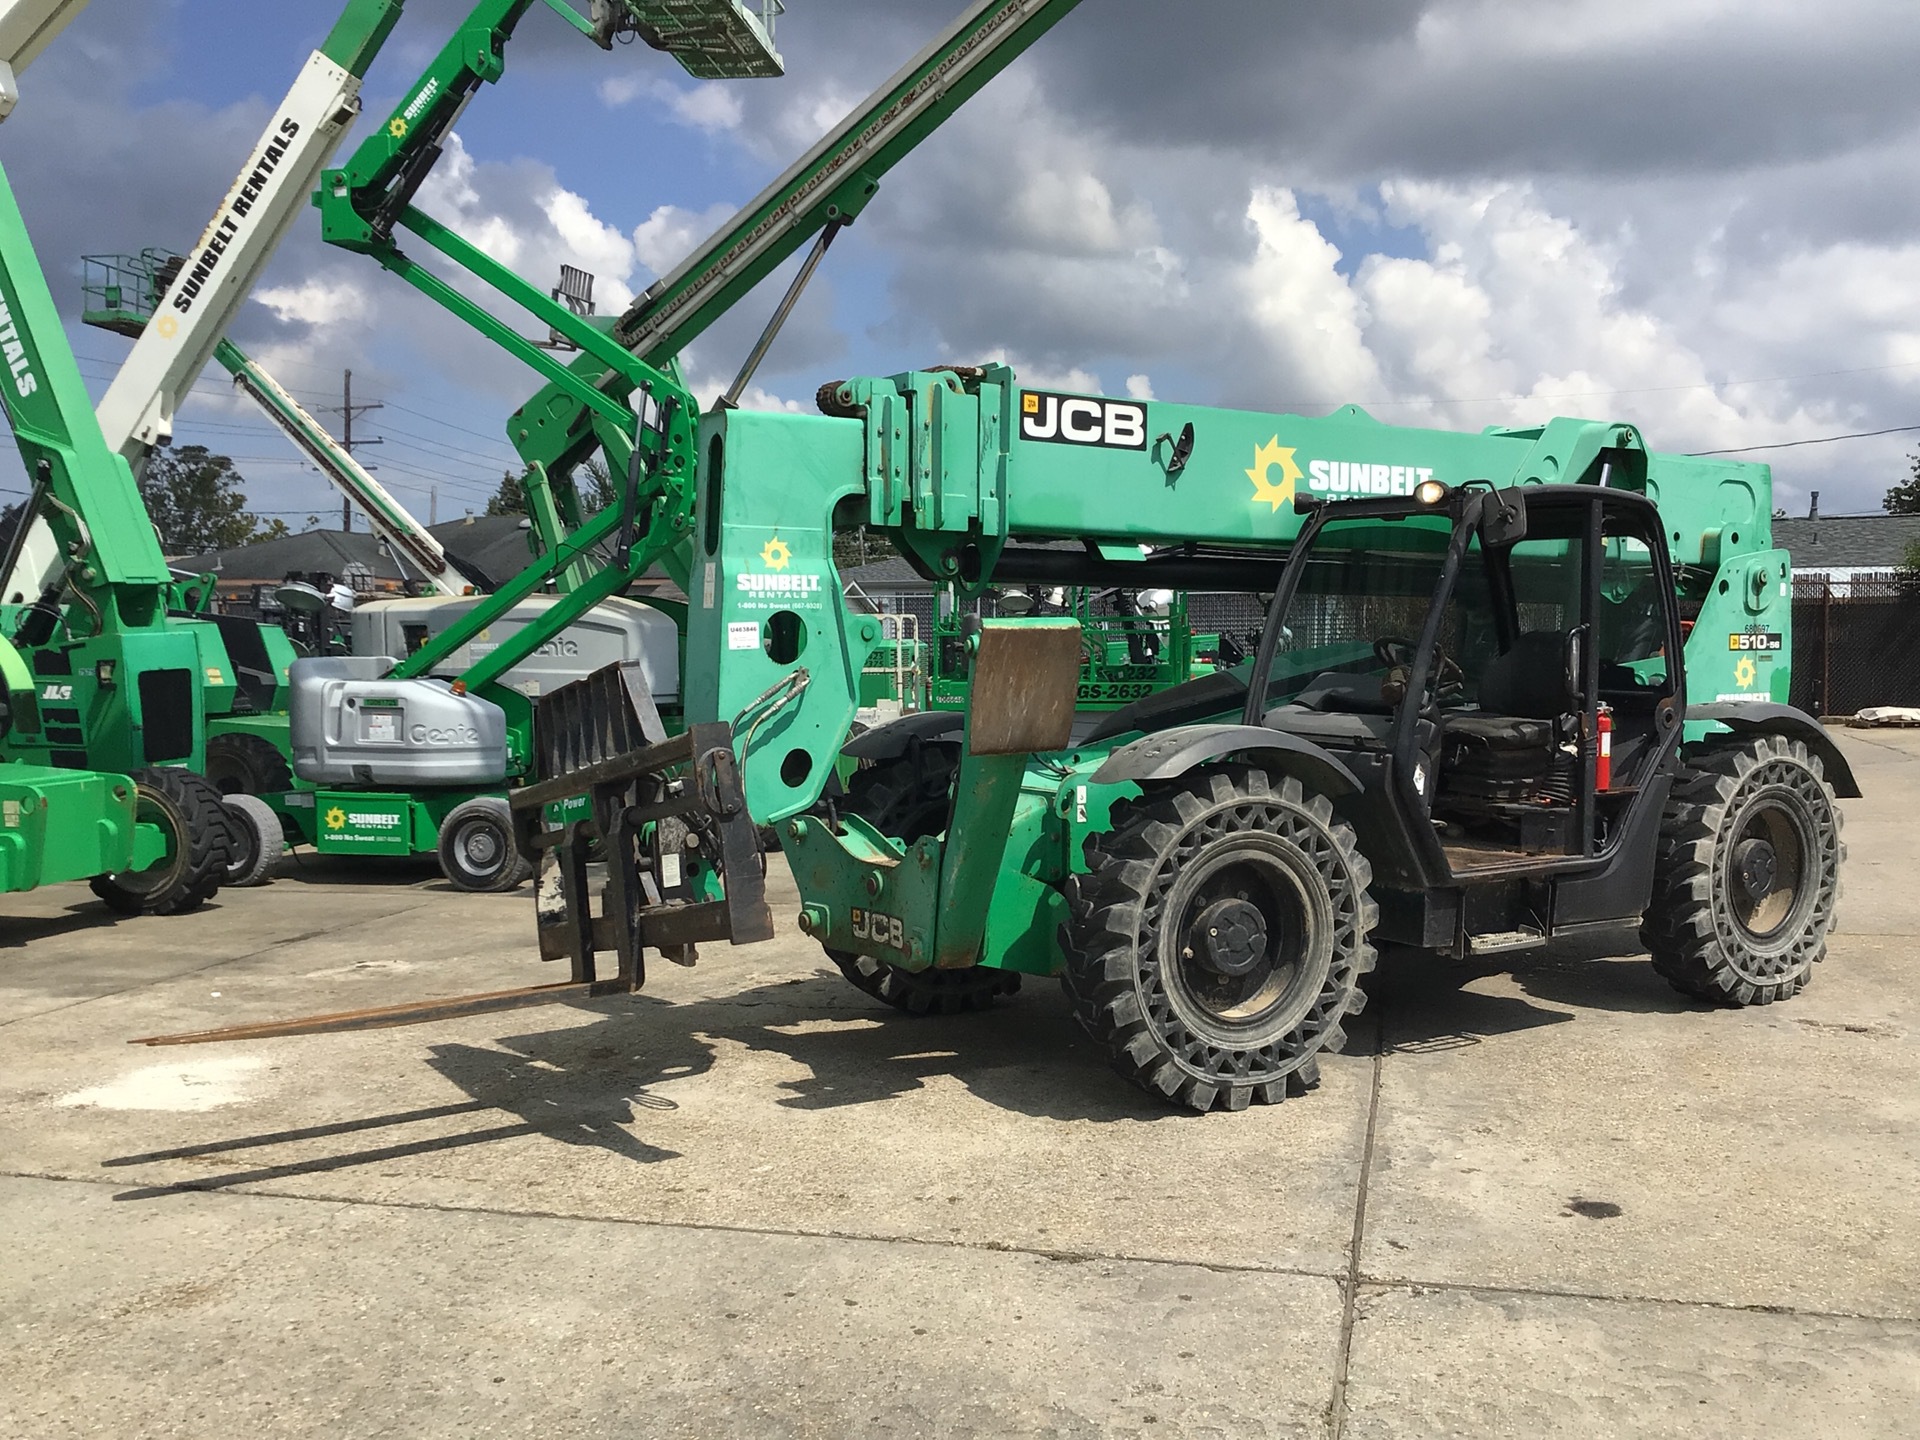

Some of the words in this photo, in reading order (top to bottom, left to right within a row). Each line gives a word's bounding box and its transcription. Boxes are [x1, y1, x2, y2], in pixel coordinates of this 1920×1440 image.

[403, 76, 438, 120] SUNBELT
[173, 215, 238, 314] SUNBELT
[231, 117, 300, 219] RENTALS
[0, 287, 37, 397] NTALS
[1023, 396, 1144, 446] JCB
[1309, 459, 1433, 496] SUNBELT
[737, 573, 821, 591] SUNBELT
[748, 591, 809, 599] RENTALS
[42, 685, 73, 700] JLG
[1077, 684, 1153, 699] GS-2632
[408, 723, 479, 745] Genie
[563, 797, 586, 810] Power
[348, 813, 401, 825] SUNBELT
[853, 911, 903, 949] JCB
